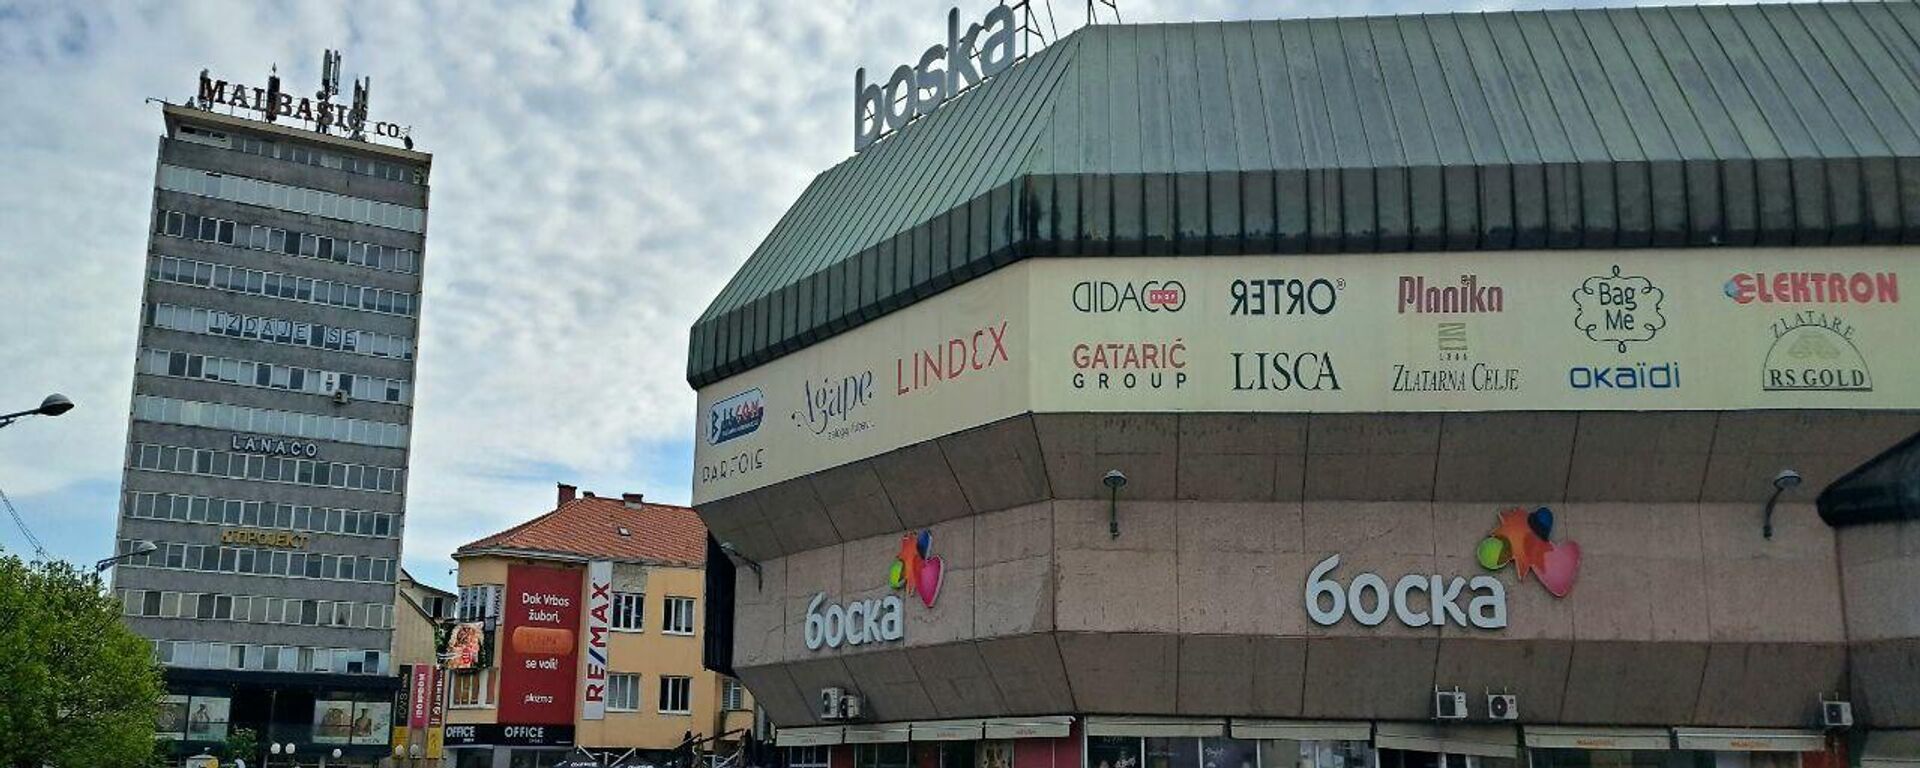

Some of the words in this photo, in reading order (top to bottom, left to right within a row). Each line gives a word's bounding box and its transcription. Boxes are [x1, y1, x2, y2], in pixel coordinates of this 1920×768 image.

[855, 5, 1016, 152] boska
[1397, 274, 1503, 314] Planika
[1599, 282, 1636, 311] Bag
[1731, 272, 1900, 304] ELEKTRON
[214, 310, 307, 340] IZDAJE
[328, 327, 357, 346] SE
[1605, 309, 1635, 331] Me
[1769, 310, 1856, 341] ZLATARE
[897, 321, 1009, 396] LINDEX
[1072, 338, 1187, 369] GATARIĆ
[1072, 373, 1187, 389] GROUP
[1230, 351, 1342, 391] LISCA
[1393, 364, 1467, 391] ZLATARNA
[1472, 362, 1520, 391] CELJE
[1769, 369, 1796, 387] RS
[1802, 369, 1866, 387] GOLD
[232, 434, 318, 456] LANACO
[522, 592, 542, 605] Dok
[1305, 552, 1508, 628] боска
[805, 592, 904, 650] боска
[585, 581, 611, 702] RE/MAX
[525, 660, 537, 669] se
[446, 726, 476, 738] OFFICE
[504, 726, 544, 738] OFFICE
